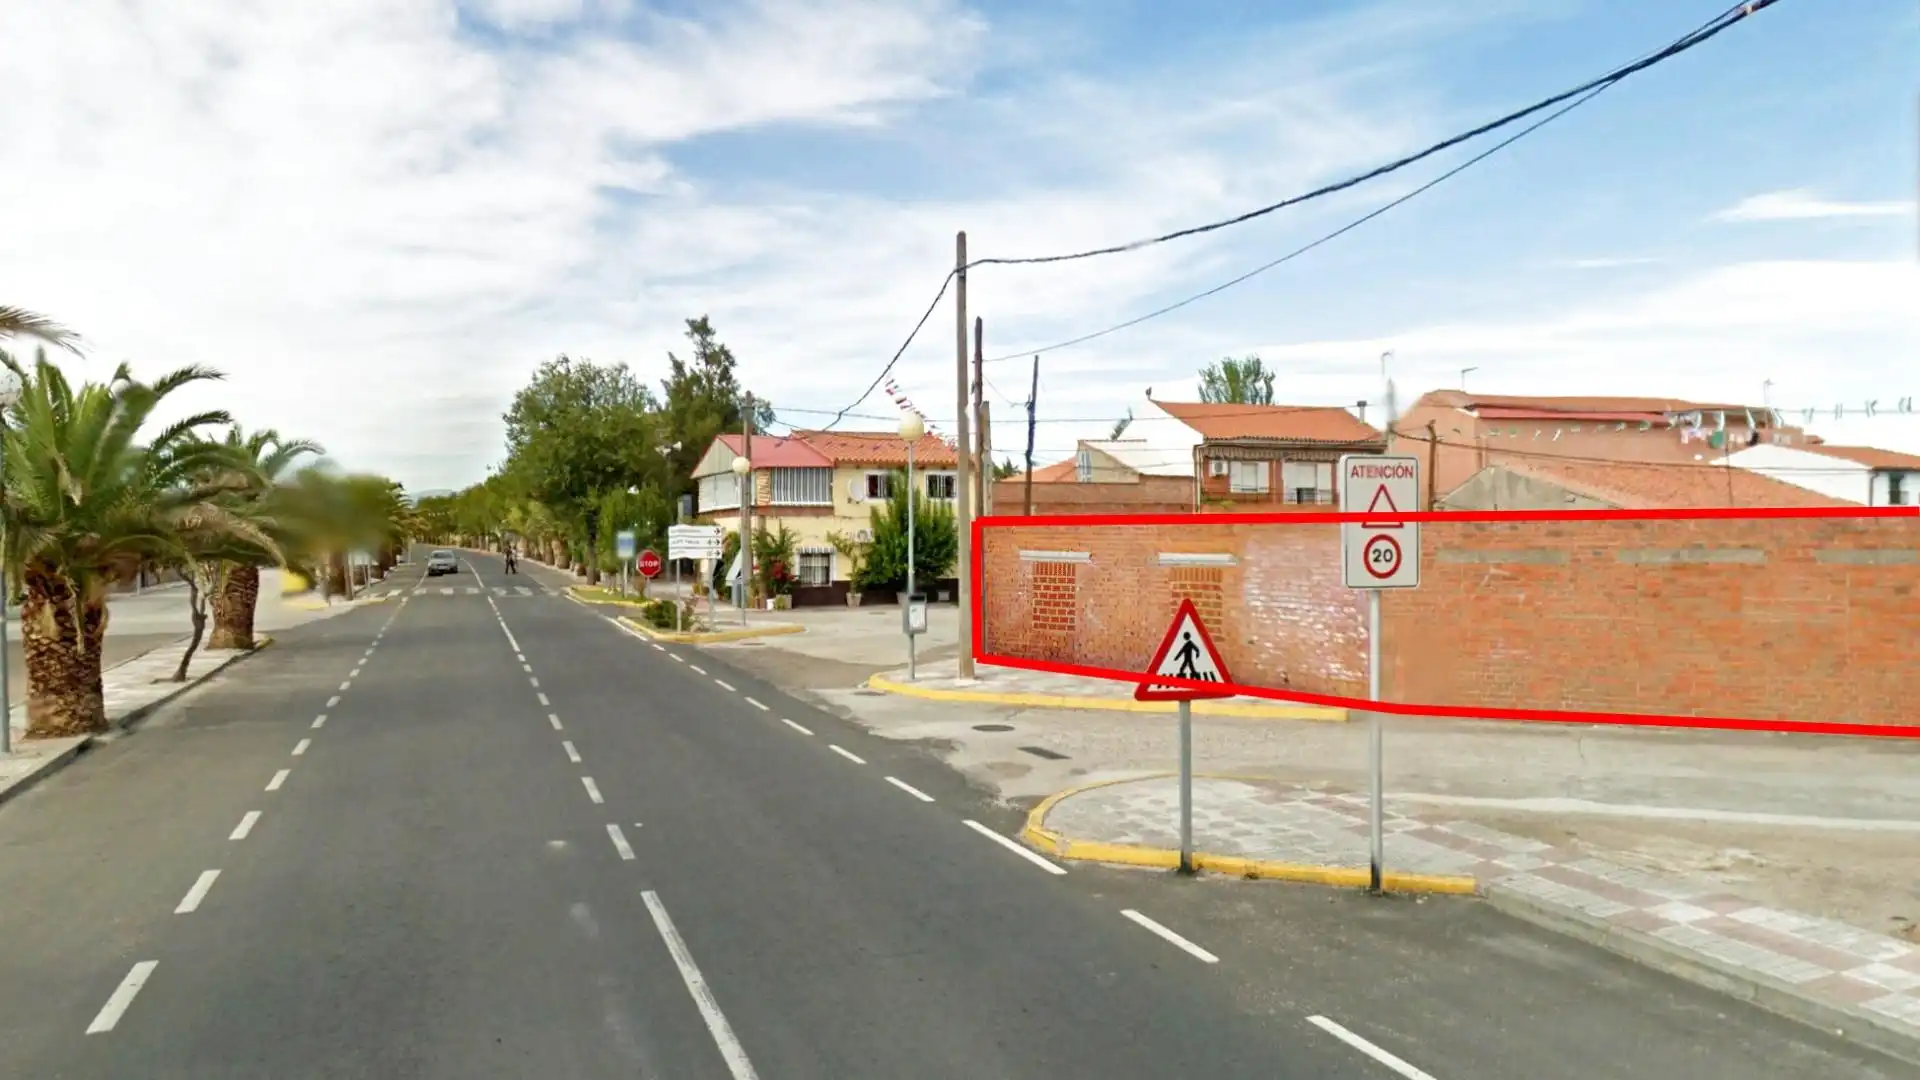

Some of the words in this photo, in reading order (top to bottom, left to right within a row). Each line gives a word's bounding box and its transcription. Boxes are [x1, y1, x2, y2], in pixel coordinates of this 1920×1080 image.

[1350, 463, 1415, 479] ATENCIÓN
[1372, 548, 1394, 563] 20
[639, 560, 659, 568] STOP
